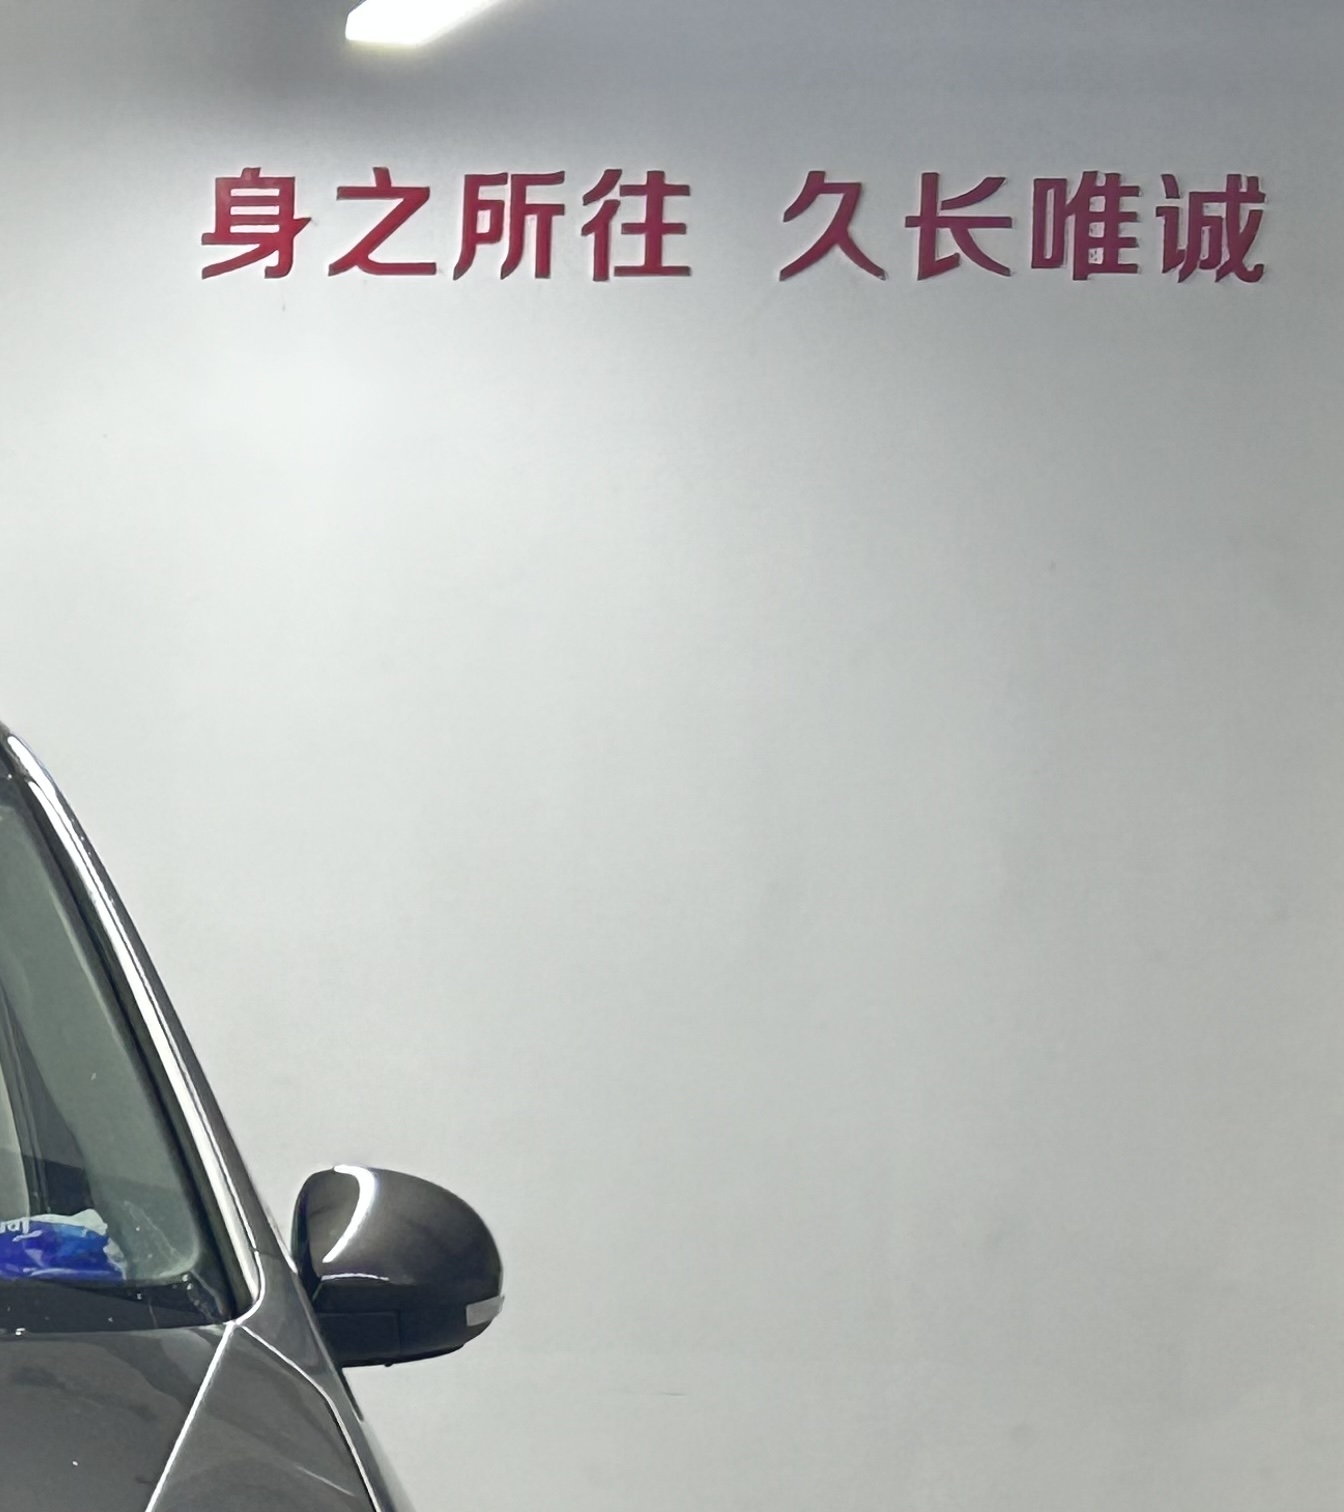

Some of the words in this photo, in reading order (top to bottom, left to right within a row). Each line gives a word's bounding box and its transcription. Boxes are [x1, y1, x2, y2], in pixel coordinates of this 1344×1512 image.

[201, 167, 692, 282] 身之所往
[779, 169, 1266, 283] 久长唯诚
